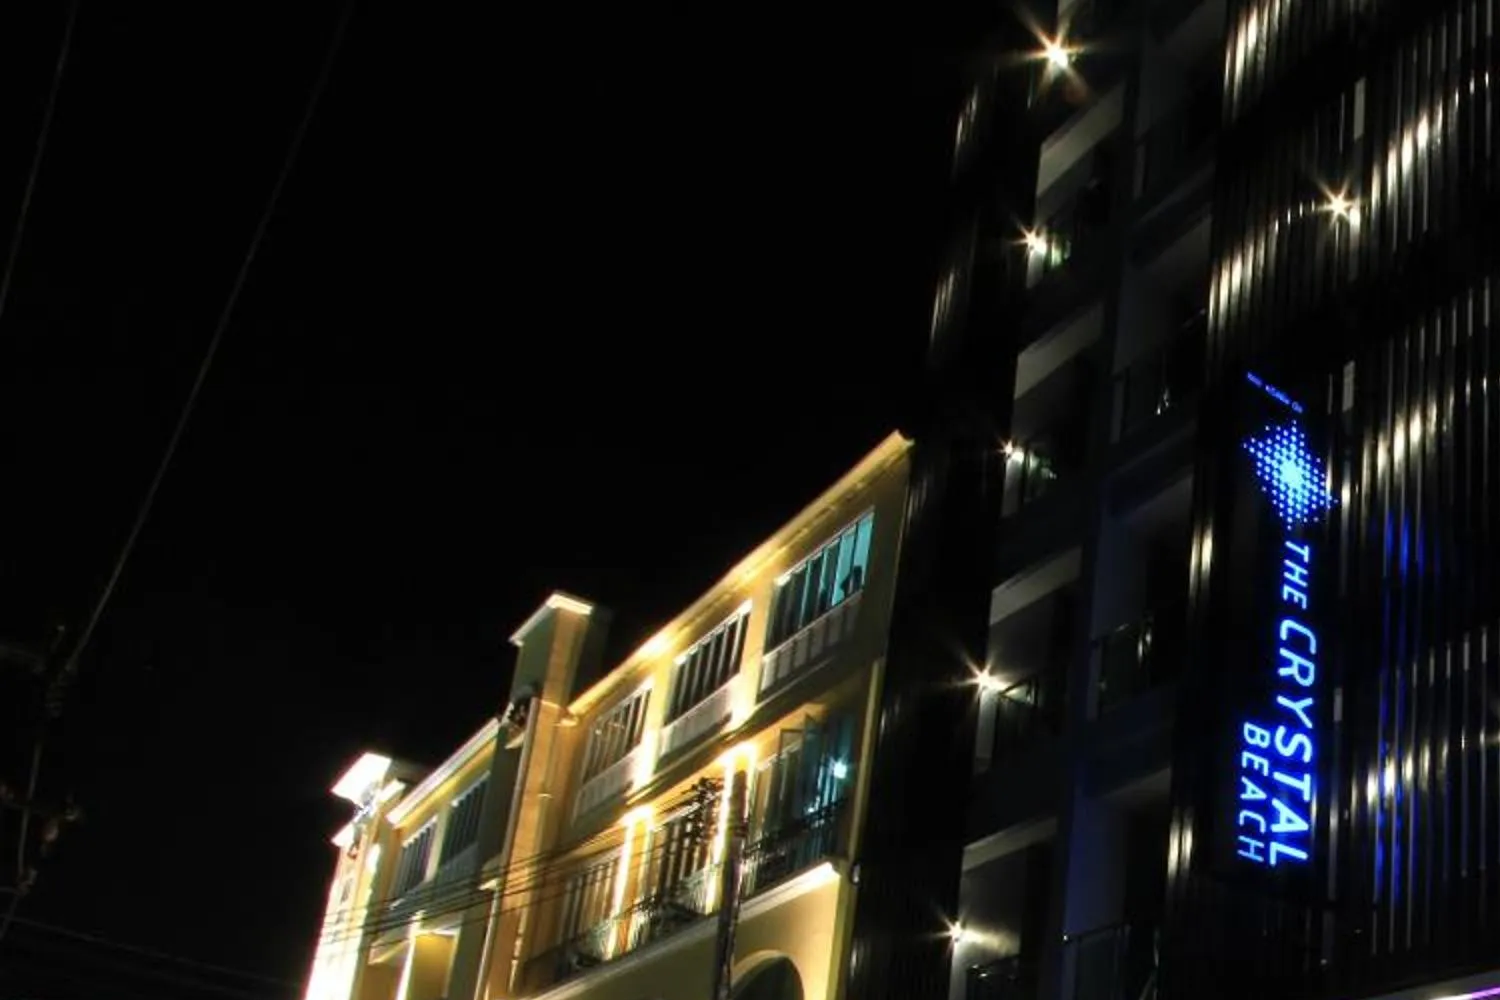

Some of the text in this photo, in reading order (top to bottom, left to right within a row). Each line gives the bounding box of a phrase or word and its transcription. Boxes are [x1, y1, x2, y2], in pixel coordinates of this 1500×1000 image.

[1237, 721, 1271, 863] BEACH
[1269, 539, 1317, 867] THE CRYSTAL
